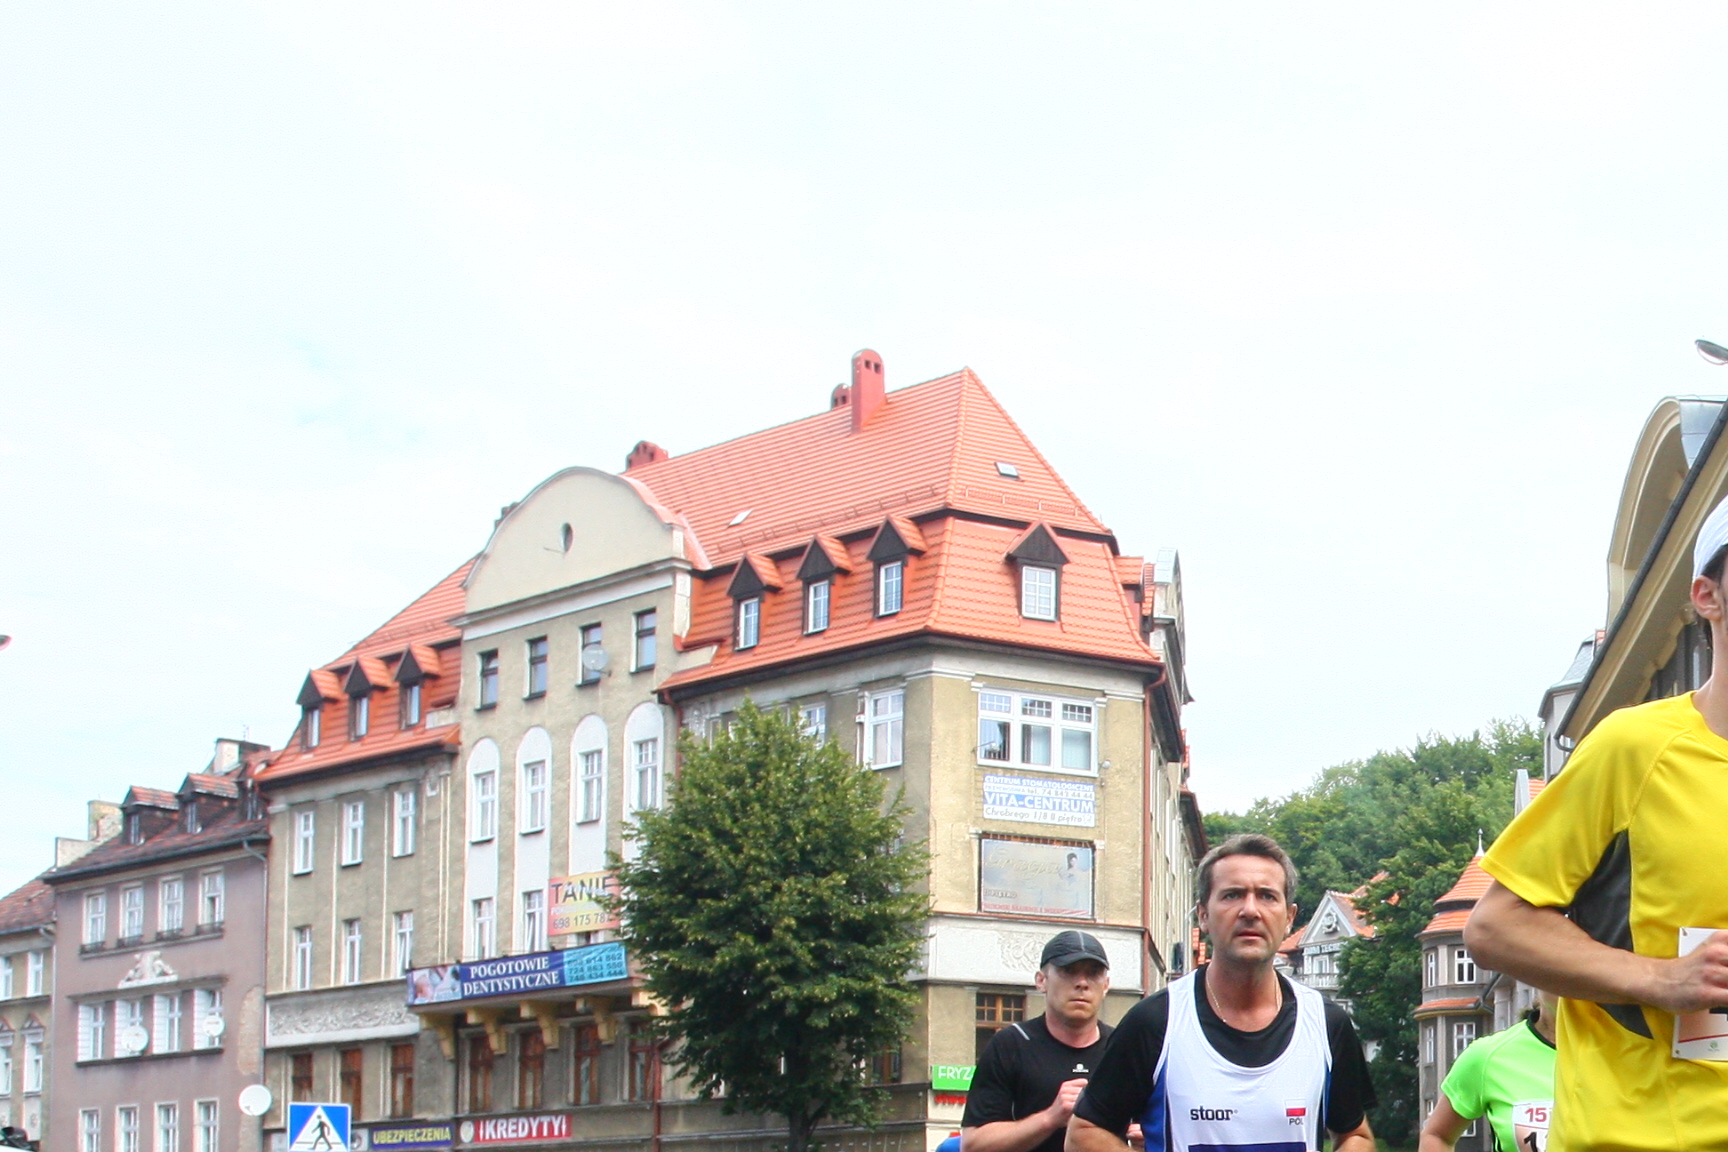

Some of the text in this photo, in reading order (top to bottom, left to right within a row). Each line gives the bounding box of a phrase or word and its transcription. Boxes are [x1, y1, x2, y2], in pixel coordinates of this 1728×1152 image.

[984, 791, 1094, 813] VITA-CENTRUM
[551, 875, 614, 904] TANIE
[574, 914, 591, 926] 175
[469, 956, 550, 979] POGOTOWIE
[463, 971, 561, 996] DENTYSTYCZNE
[938, 1066, 973, 1080] FRYZ
[1524, 1107, 1547, 1123] 15
[373, 1126, 451, 1145] UBEZPIECZENIA
[485, 1115, 560, 1140] KREDYTY
